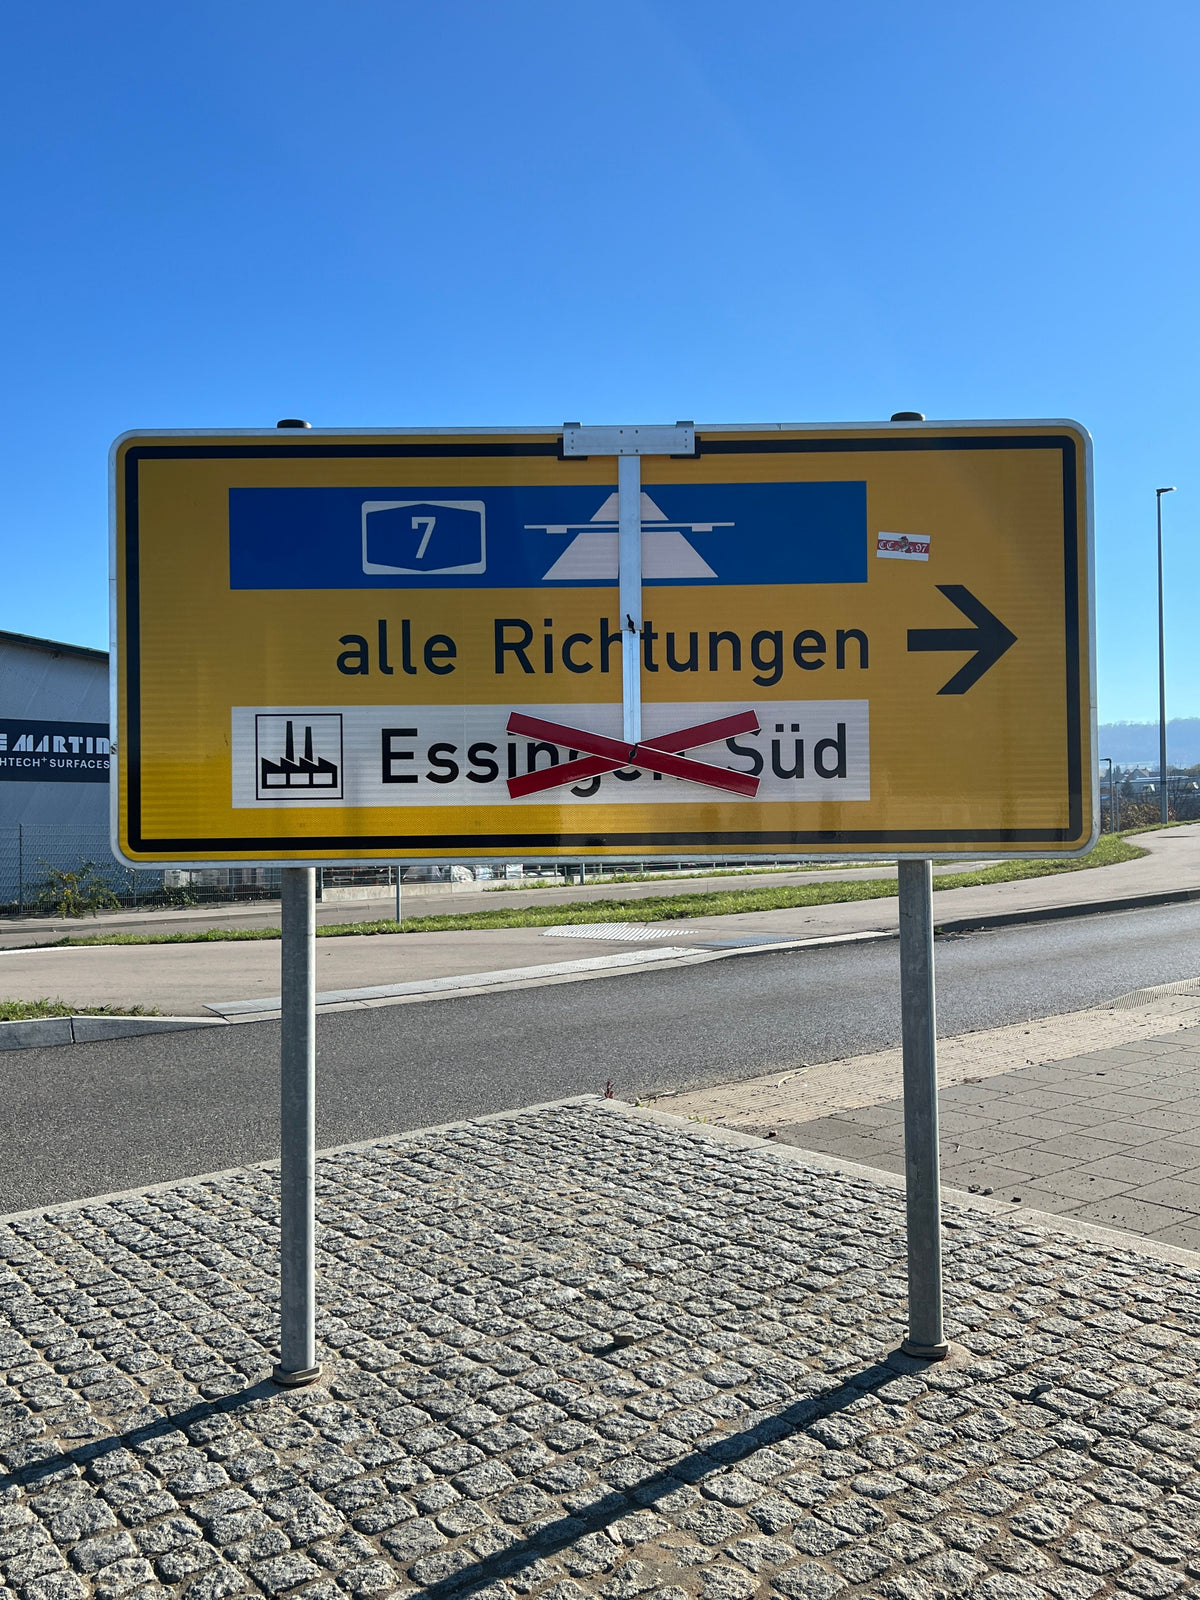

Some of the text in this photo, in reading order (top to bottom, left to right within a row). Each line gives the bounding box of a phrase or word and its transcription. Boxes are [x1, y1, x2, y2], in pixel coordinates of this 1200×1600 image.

[411, 517, 436, 559] 7
[336, 617, 869, 687] alle Richtungen
[49, 758, 110, 769] SURFACES
[381, 722, 847, 798] Essing Süd
